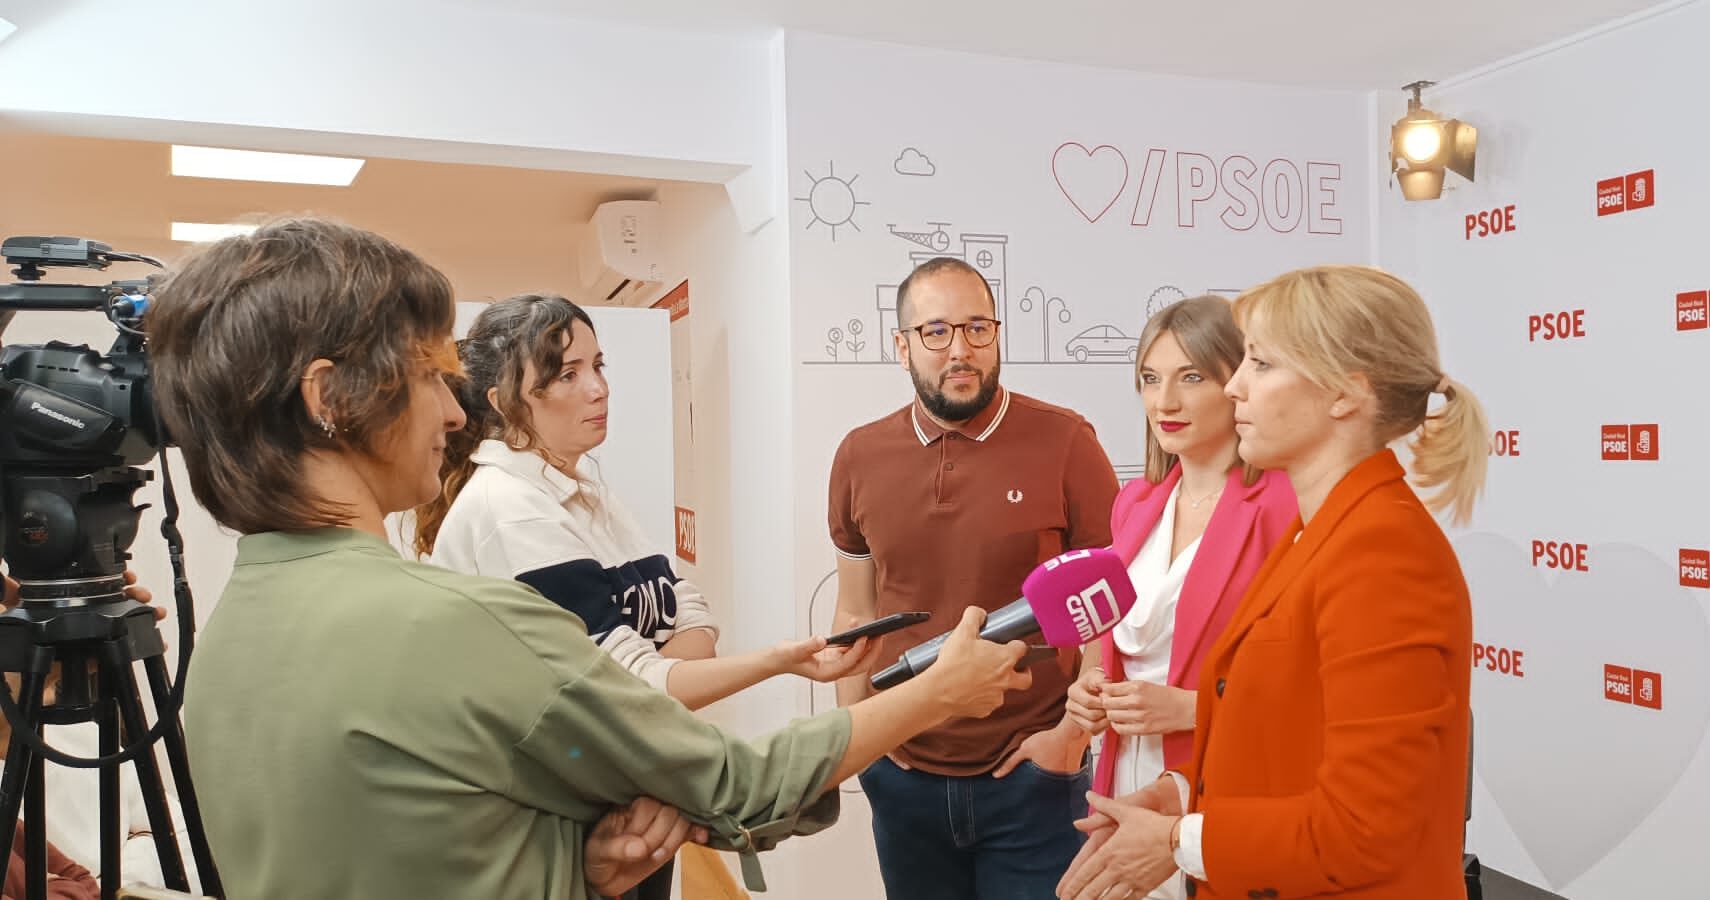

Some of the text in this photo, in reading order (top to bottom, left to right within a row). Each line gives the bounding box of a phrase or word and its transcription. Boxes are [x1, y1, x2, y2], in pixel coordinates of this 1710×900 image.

[1599, 193, 1623, 208] PSOE
[1465, 205, 1516, 240] PSOE
[1529, 310, 1585, 341] PSOE
[1679, 308, 1705, 322] PSOE
[31, 401, 85, 429] Panasonic
[1488, 430, 1520, 457] OE
[1603, 441, 1627, 453] PSOE
[1532, 540, 1589, 571] PSOE
[1681, 565, 1708, 580] PSOE
[1473, 642, 1524, 677] PSOE
[1607, 680, 1630, 696] PSOE
